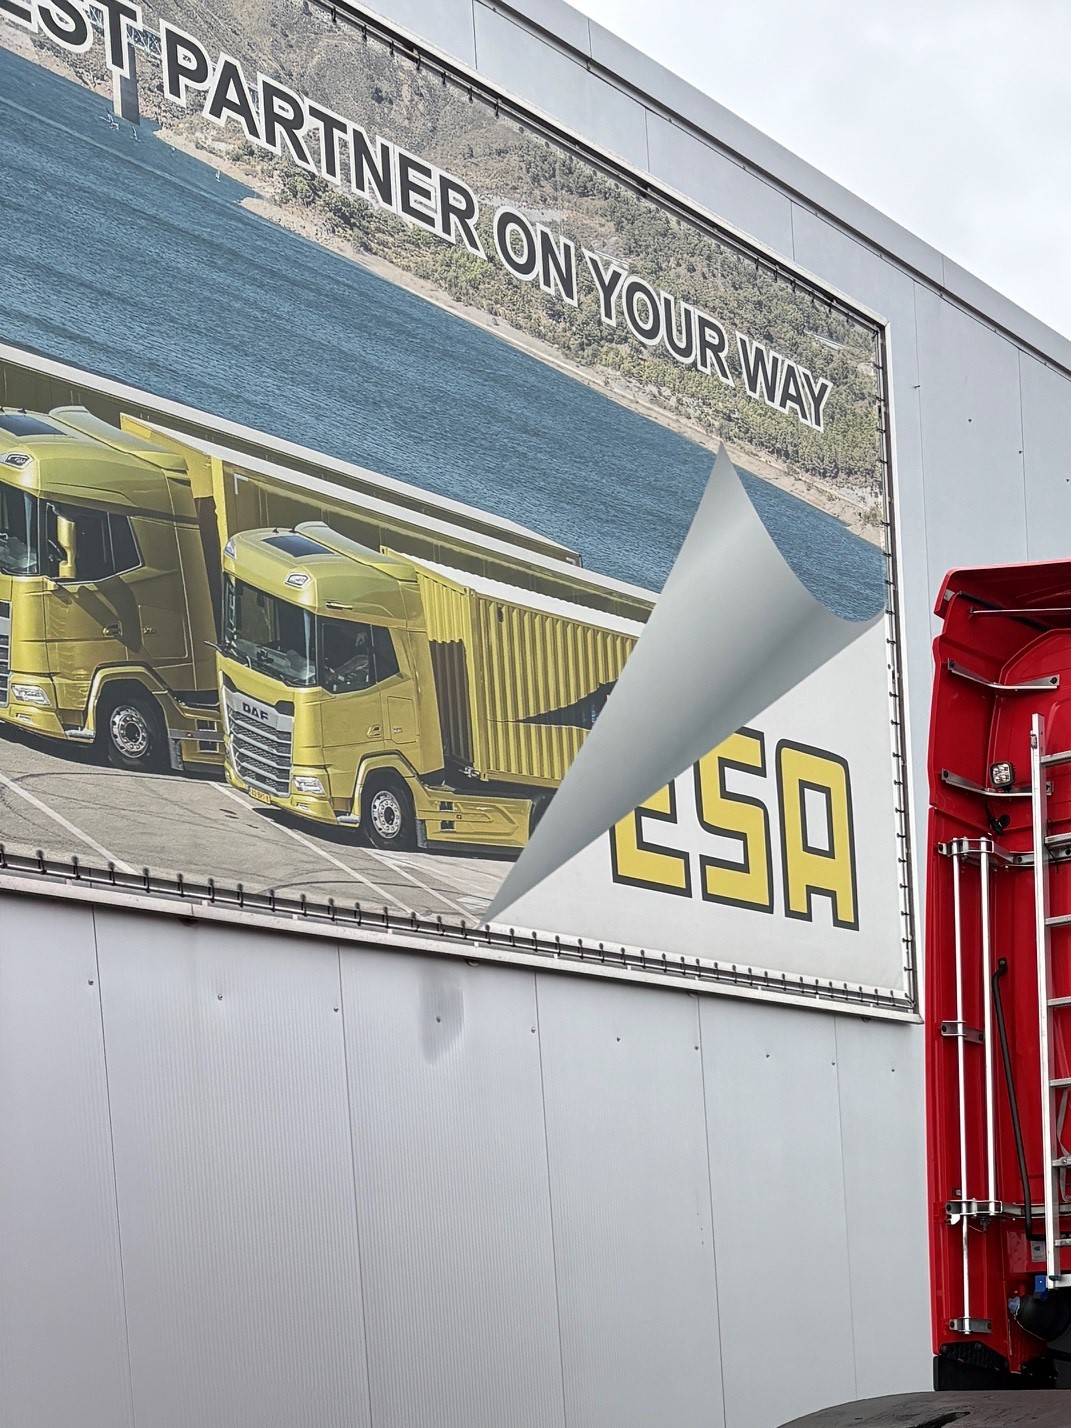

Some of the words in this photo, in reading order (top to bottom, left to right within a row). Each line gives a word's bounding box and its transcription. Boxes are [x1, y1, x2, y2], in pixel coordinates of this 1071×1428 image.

[0, 0, 138, 70] ST
[165, 28, 484, 254] PARTNER
[497, 211, 574, 300] ON
[589, 253, 732, 384] YOUR
[738, 335, 830, 428] WAY
[242, 701, 269, 721] DAF
